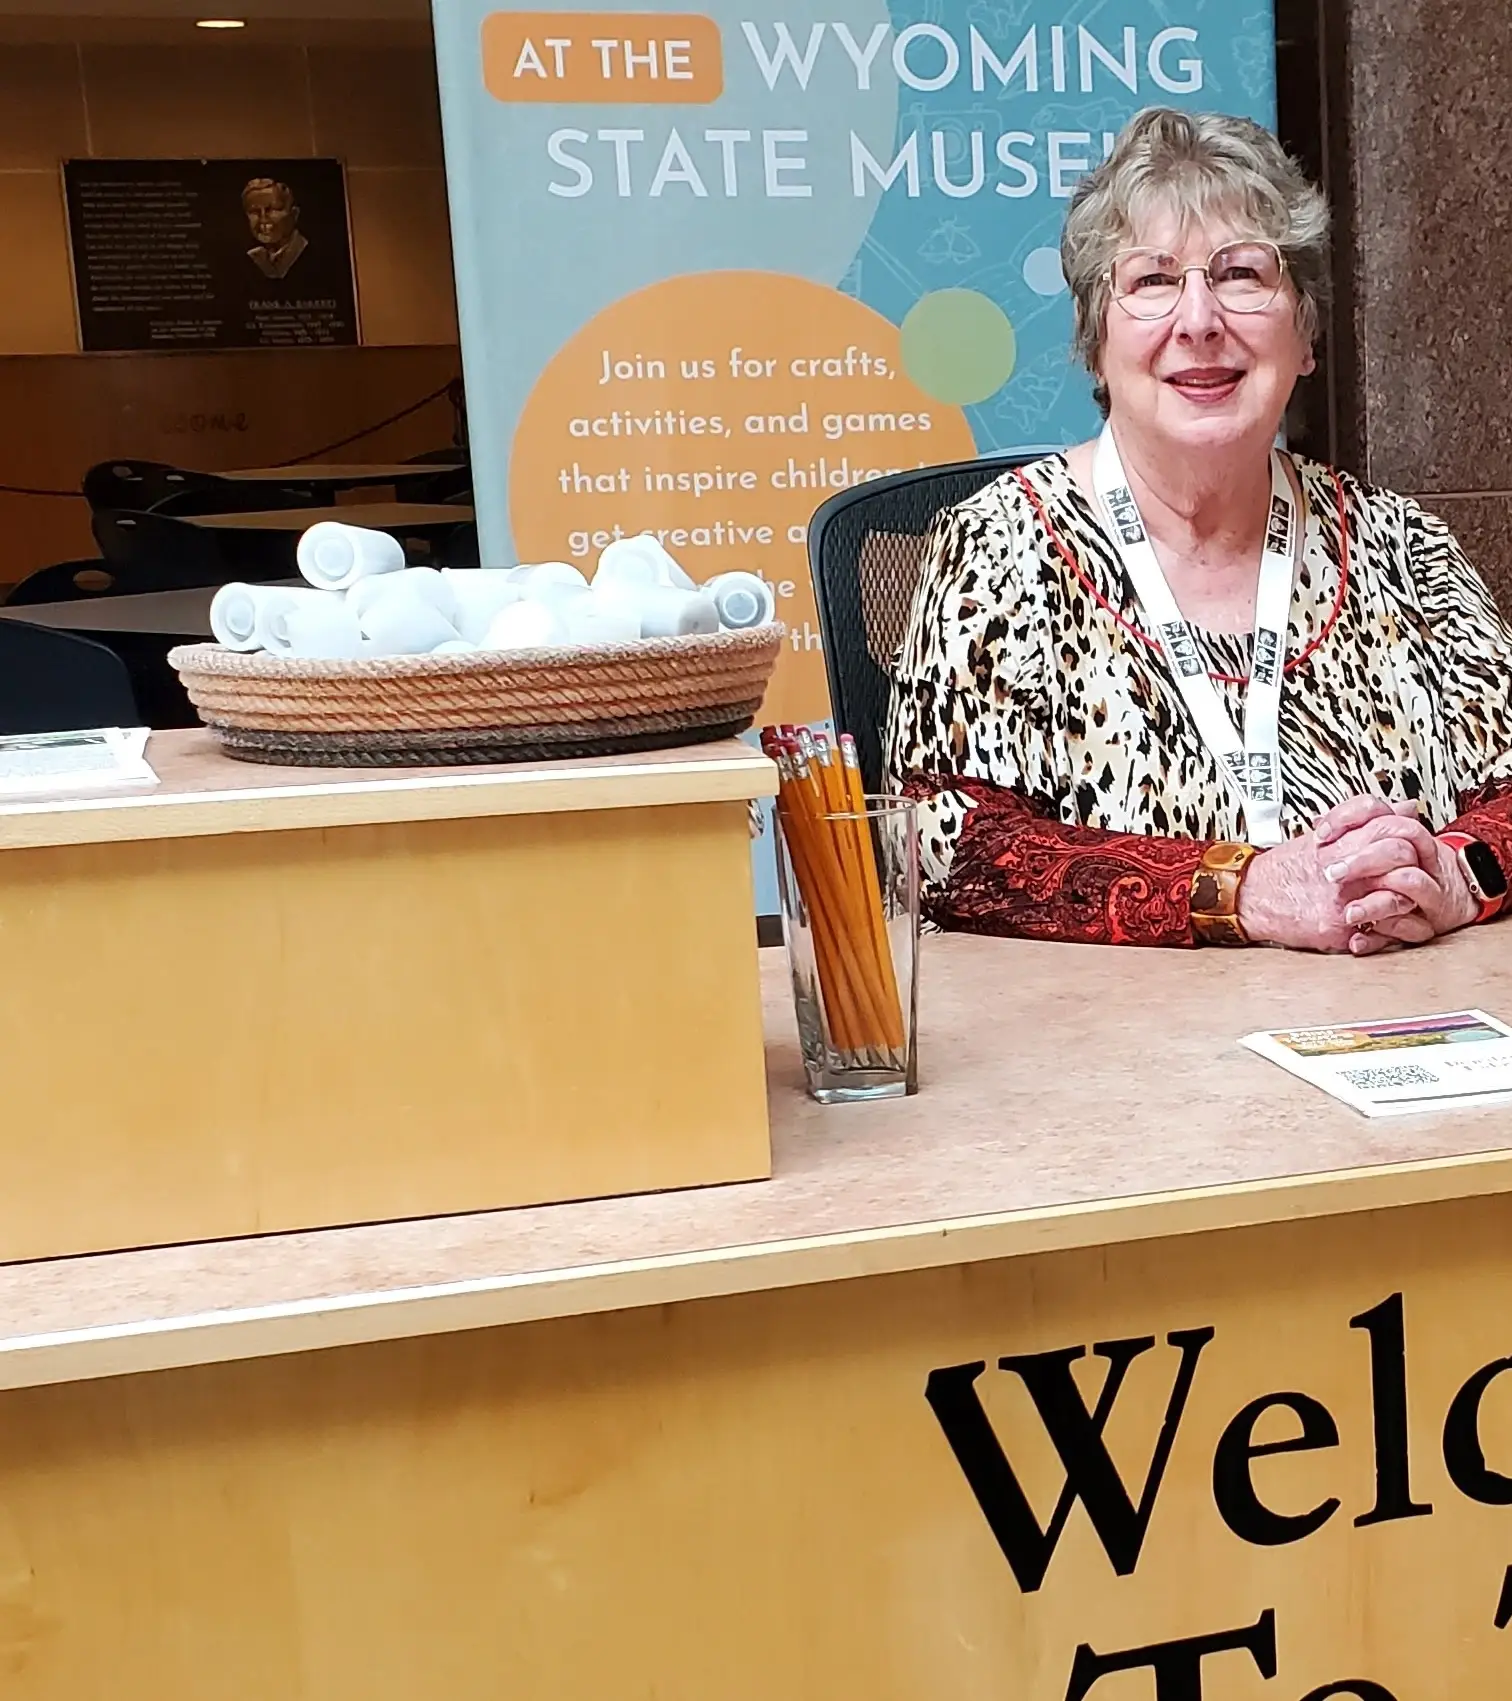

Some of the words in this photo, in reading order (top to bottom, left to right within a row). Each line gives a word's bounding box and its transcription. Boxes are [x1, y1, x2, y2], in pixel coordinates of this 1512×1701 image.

[512, 39, 572, 78] AT
[592, 39, 694, 80] THE
[742, 21, 1204, 94] WYOMING
[546, 128, 812, 198] STATE
[849, 130, 1115, 198] MUSE
[599, 350, 666, 385] Join
[680, 358, 716, 380] us
[728, 347, 777, 379] for
[790, 346, 897, 380] crafts,
[568, 410, 731, 438] activities,
[744, 403, 809, 434] and
[823, 411, 932, 440] games
[558, 463, 631, 494] that
[644, 464, 758, 498] inspire
[567, 524, 625, 557] get
